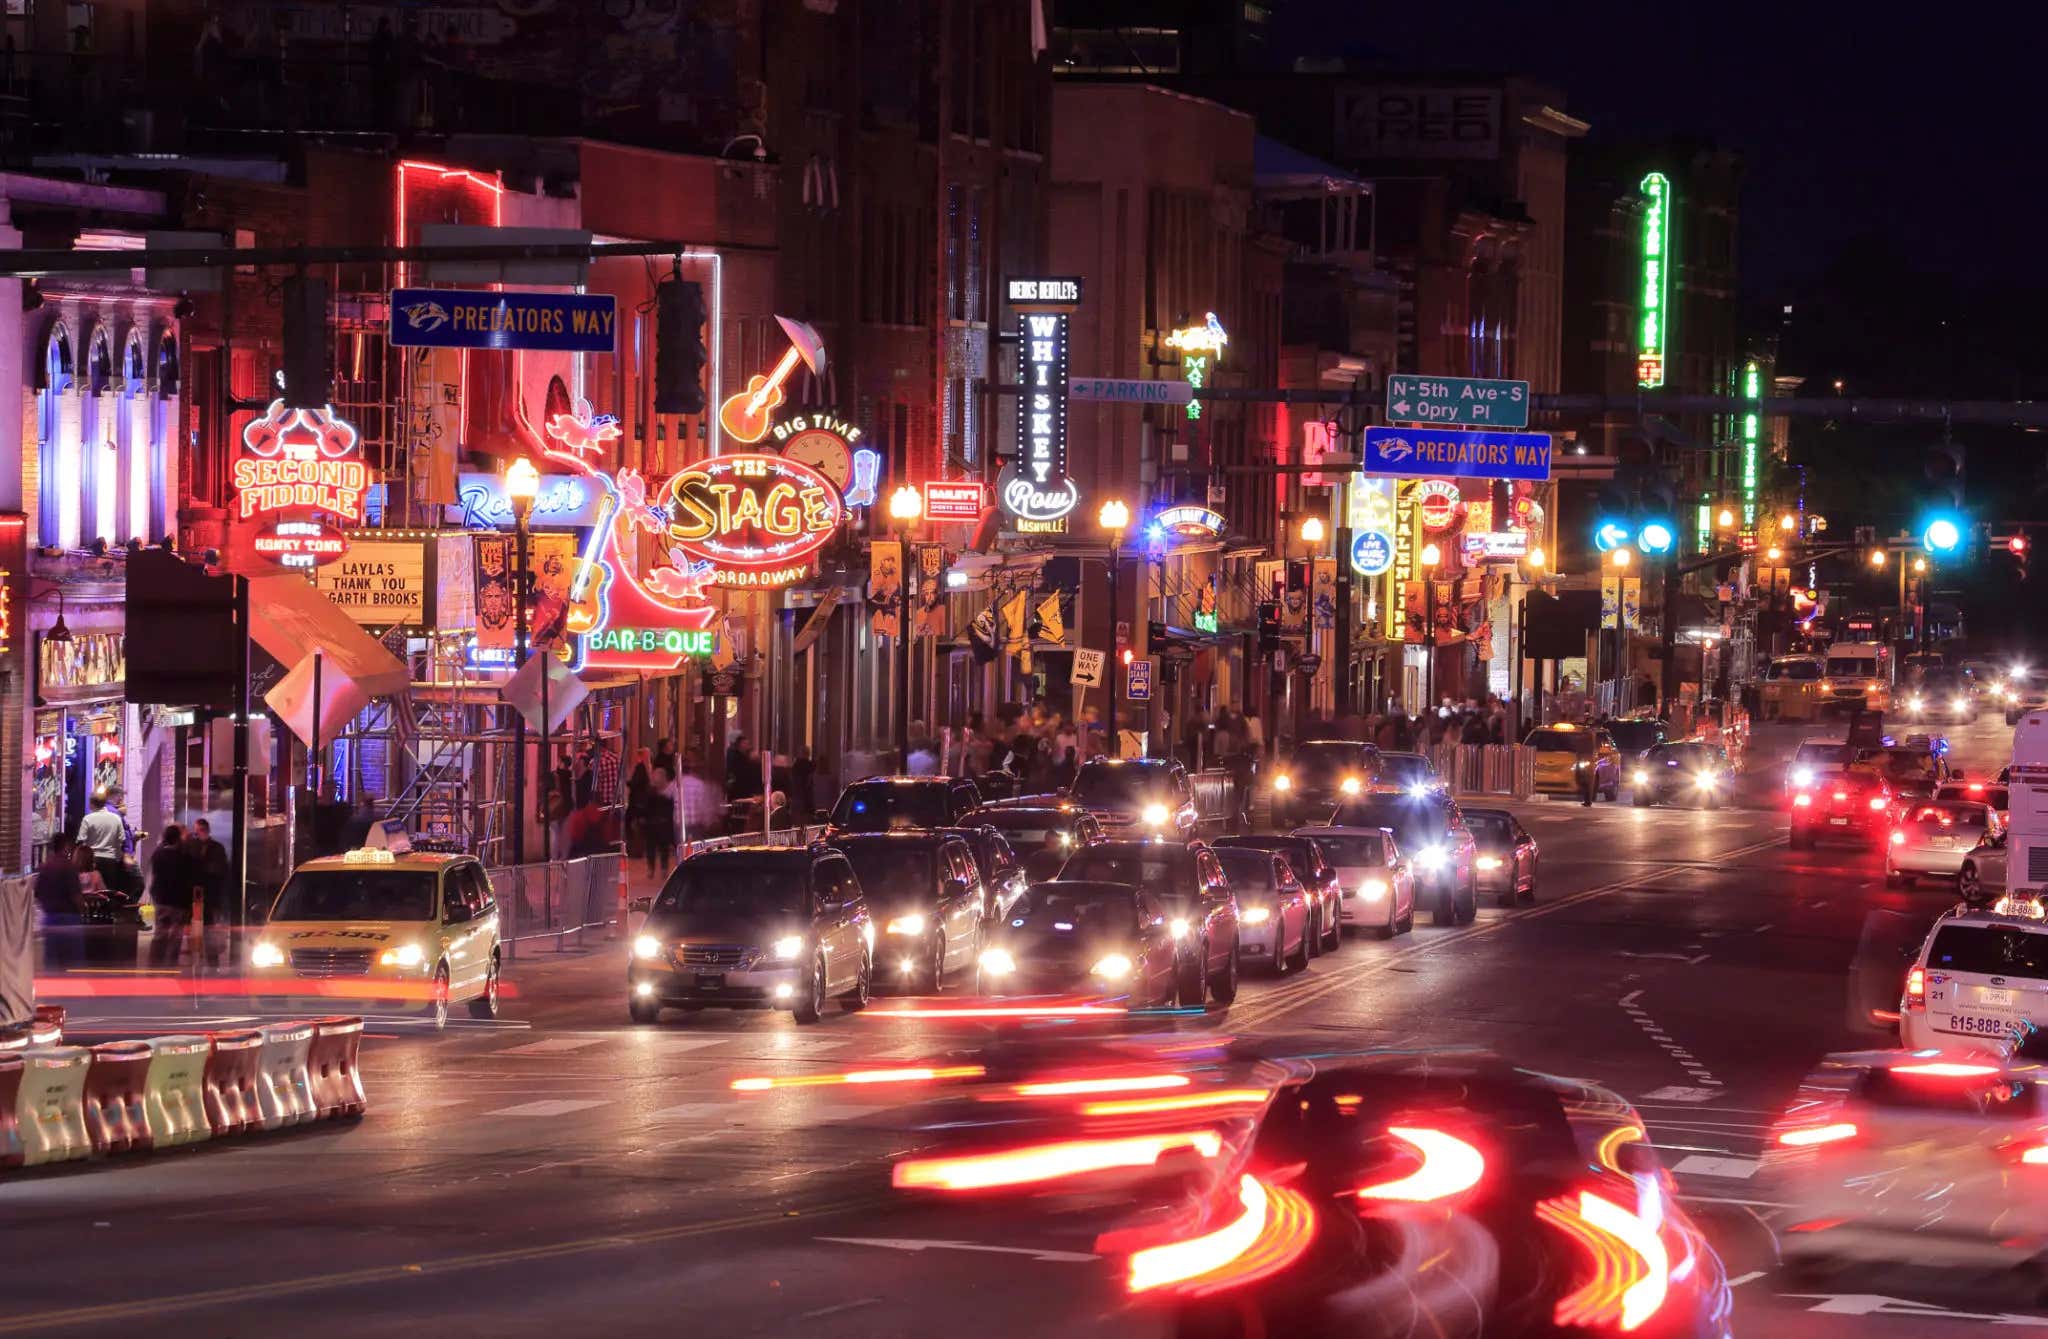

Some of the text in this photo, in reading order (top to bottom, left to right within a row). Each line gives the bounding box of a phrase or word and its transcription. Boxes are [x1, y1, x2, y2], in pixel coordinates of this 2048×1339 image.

[453, 305, 613, 335] PREDATORS WAY
[1094, 381, 1168, 400] PARKING
[1028, 316, 1057, 483] WHISKEY
[1417, 402, 1490, 421] Opry Pl
[772, 414, 863, 442] BIG TIME
[282, 443, 318, 460] THE
[1416, 441, 1549, 466] PREDATORS WAY
[234, 458, 365, 491] SECOND
[732, 459, 767, 476] THE
[240, 484, 358, 519] FIDDLE
[669, 470, 834, 541] STAGE
[1010, 480, 1070, 515] Row
[277, 522, 321, 536] MUSIC
[1018, 519, 1064, 533] NASHVILLE
[1363, 540, 1381, 549] LIVE
[1368, 532, 1376, 540] A
[255, 539, 343, 552] HONKY TONK
[281, 553, 315, 566] CITY
[342, 563, 394, 575] LAYLA'S
[717, 565, 807, 586] BROADWAY
[333, 577, 406, 590] THANK YOU
[328, 592, 418, 604] GARTH BROOKS
[590, 629, 712, 653] BAR-B-QUE
[1079, 651, 1100, 662] ONE
[1077, 660, 1099, 672] WAY
[1130, 671, 1149, 679] STAND
[1932, 991, 1944, 1000] 21
